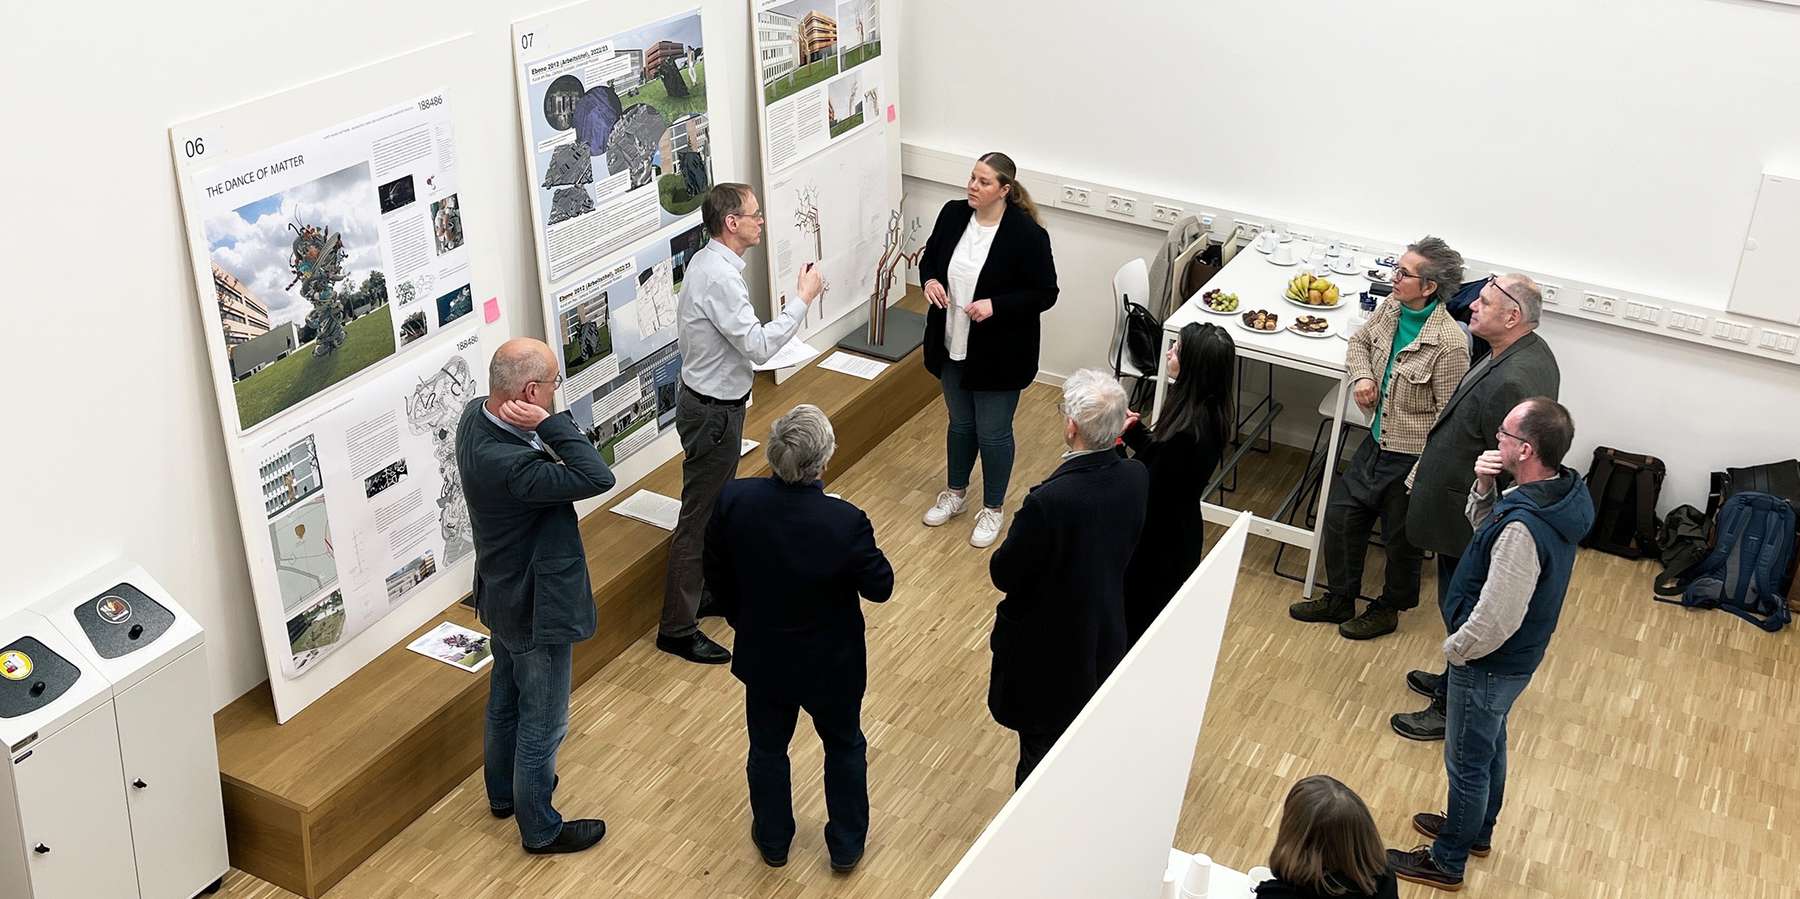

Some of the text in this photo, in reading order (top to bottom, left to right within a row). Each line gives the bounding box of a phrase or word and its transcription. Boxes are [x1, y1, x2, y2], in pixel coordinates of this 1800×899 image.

[521, 33, 534, 49] 07
[417, 95, 443, 111] 188486
[185, 137, 205, 158] 06
[206, 154, 305, 198] THE DANCE OF MATTER
[456, 334, 479, 351] 188486
